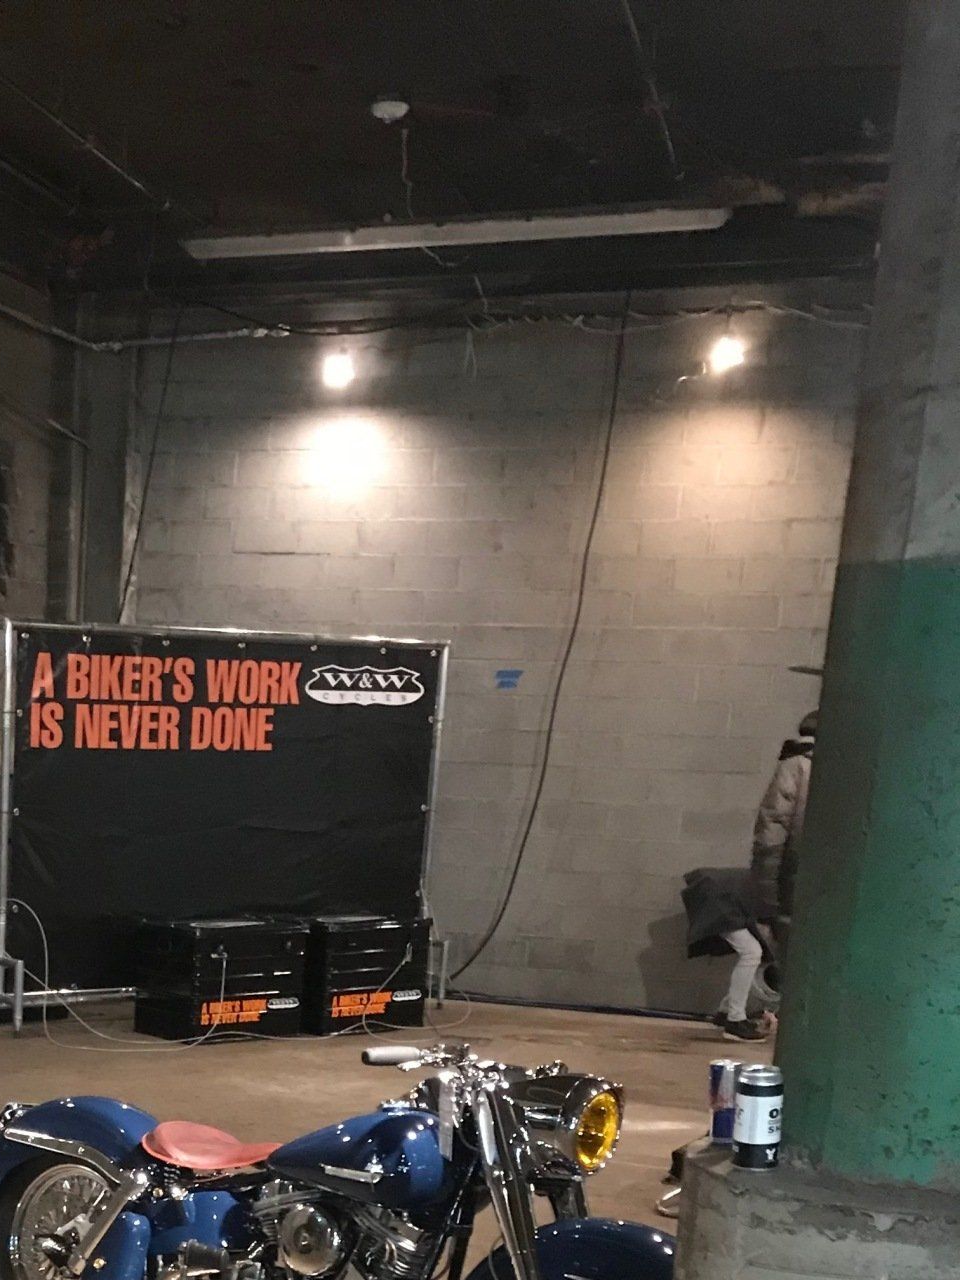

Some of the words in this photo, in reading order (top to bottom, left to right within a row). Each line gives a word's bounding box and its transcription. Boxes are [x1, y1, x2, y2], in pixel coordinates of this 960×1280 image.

[32, 652, 54, 698] A
[66, 653, 195, 702] BIKER'S
[206, 659, 302, 705] WORK
[321, 672, 411, 689] W&W
[322, 692, 407, 702] CYCLES
[29, 704, 63, 749] IS
[74, 705, 179, 750] NEVER
[190, 707, 274, 751] DONE
